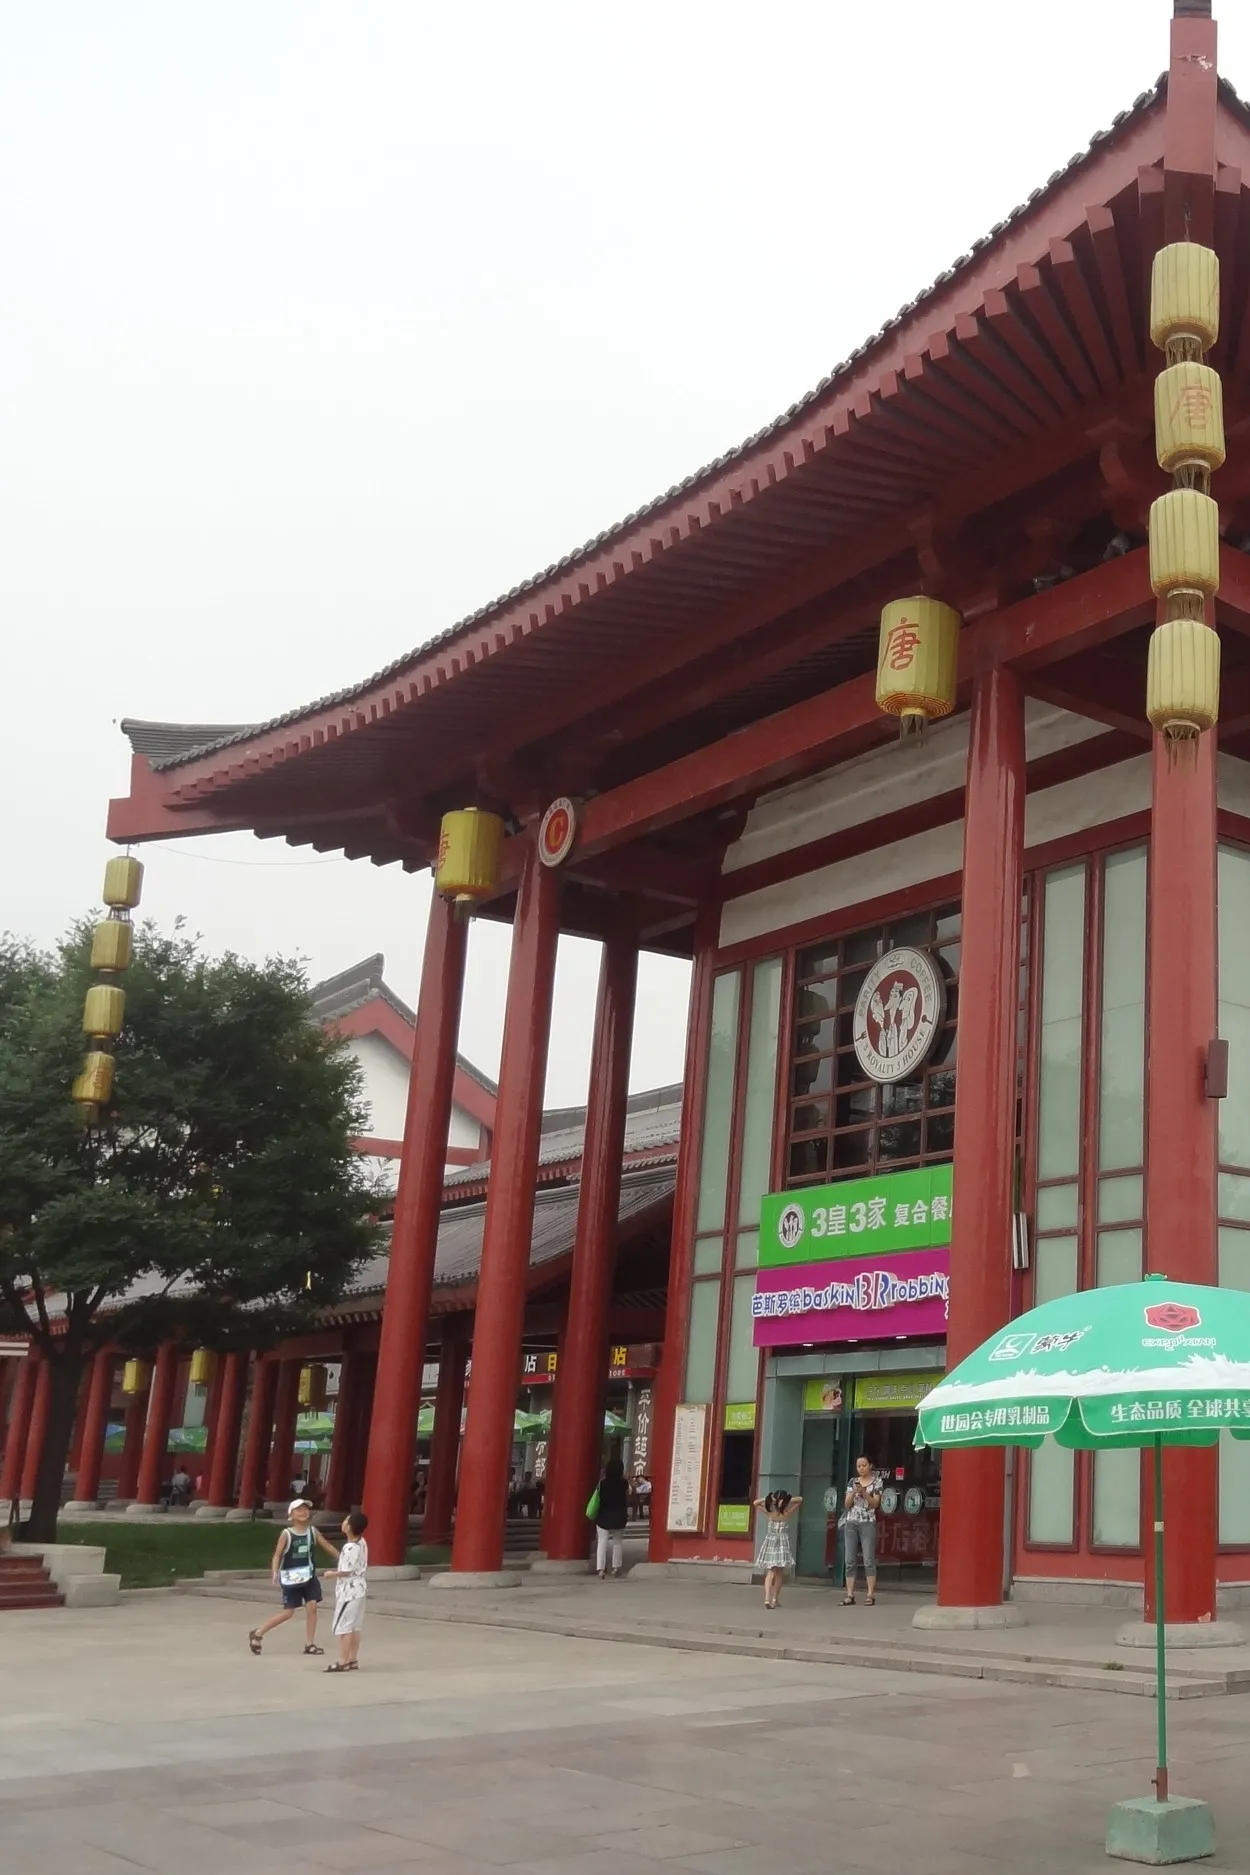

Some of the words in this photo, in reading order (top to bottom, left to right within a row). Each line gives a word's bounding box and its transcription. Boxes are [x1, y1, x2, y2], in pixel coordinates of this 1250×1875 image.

[880, 617, 922, 671] 唐
[910, 957, 933, 1004] COFFEE
[811, 1196, 888, 1238] 3皇3家
[893, 1195, 952, 1228] 复合餐
[801, 1281, 856, 1311] baskin
[939, 1406, 1051, 1434] 世园会专用乳制品
[1110, 1399, 1182, 1424] 生态品质
